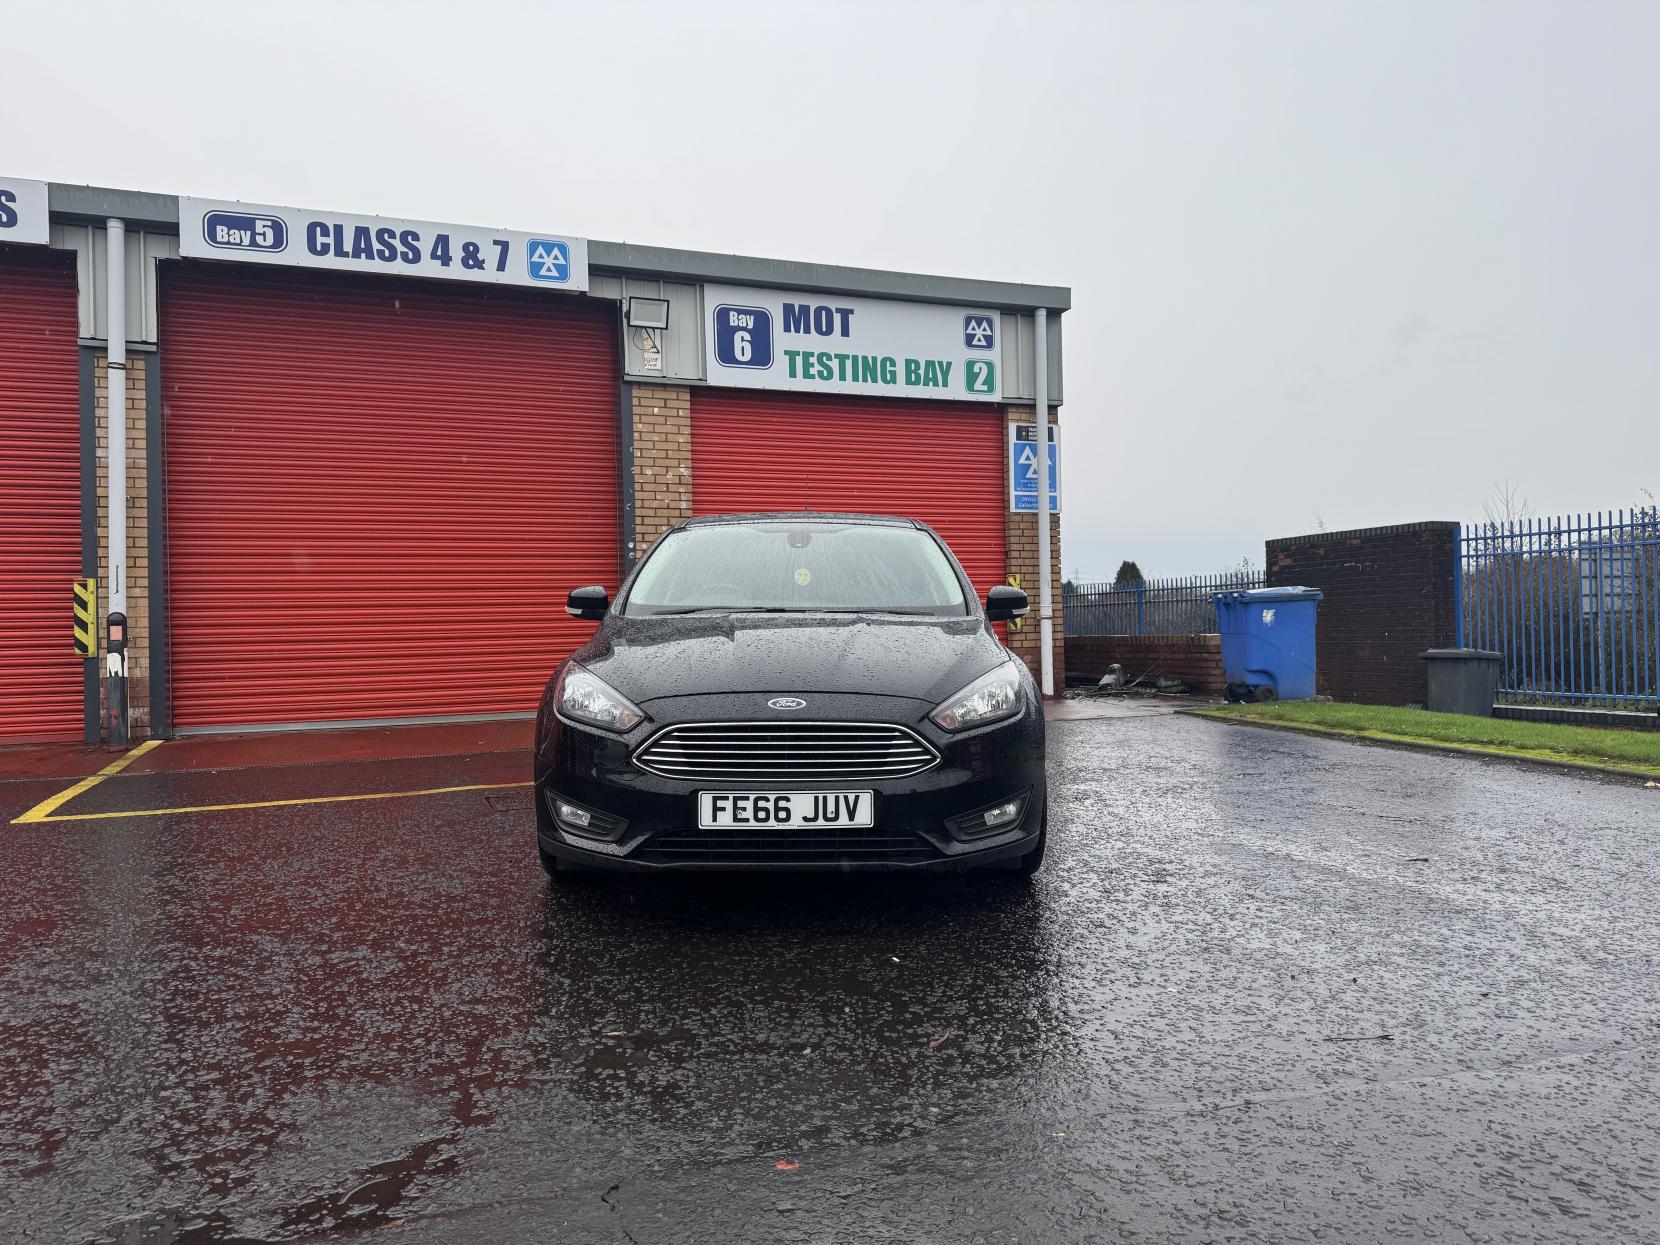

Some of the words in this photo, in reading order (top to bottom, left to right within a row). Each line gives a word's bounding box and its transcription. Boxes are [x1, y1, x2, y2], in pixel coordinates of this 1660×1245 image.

[216, 225, 251, 246] Bay
[255, 219, 274, 247] 5
[306, 221, 422, 264] CLASS
[430, 234, 453, 267] 4
[461, 241, 486, 270] &
[492, 239, 510, 272] 7
[729, 311, 754, 329] Bay
[783, 302, 855, 338] MOT
[733, 331, 752, 362] 6
[784, 350, 897, 385] TESTING
[904, 358, 953, 388] BAY
[973, 362, 989, 391] 2
[711, 795, 791, 823] FE66
[801, 794, 861, 823] JUV
